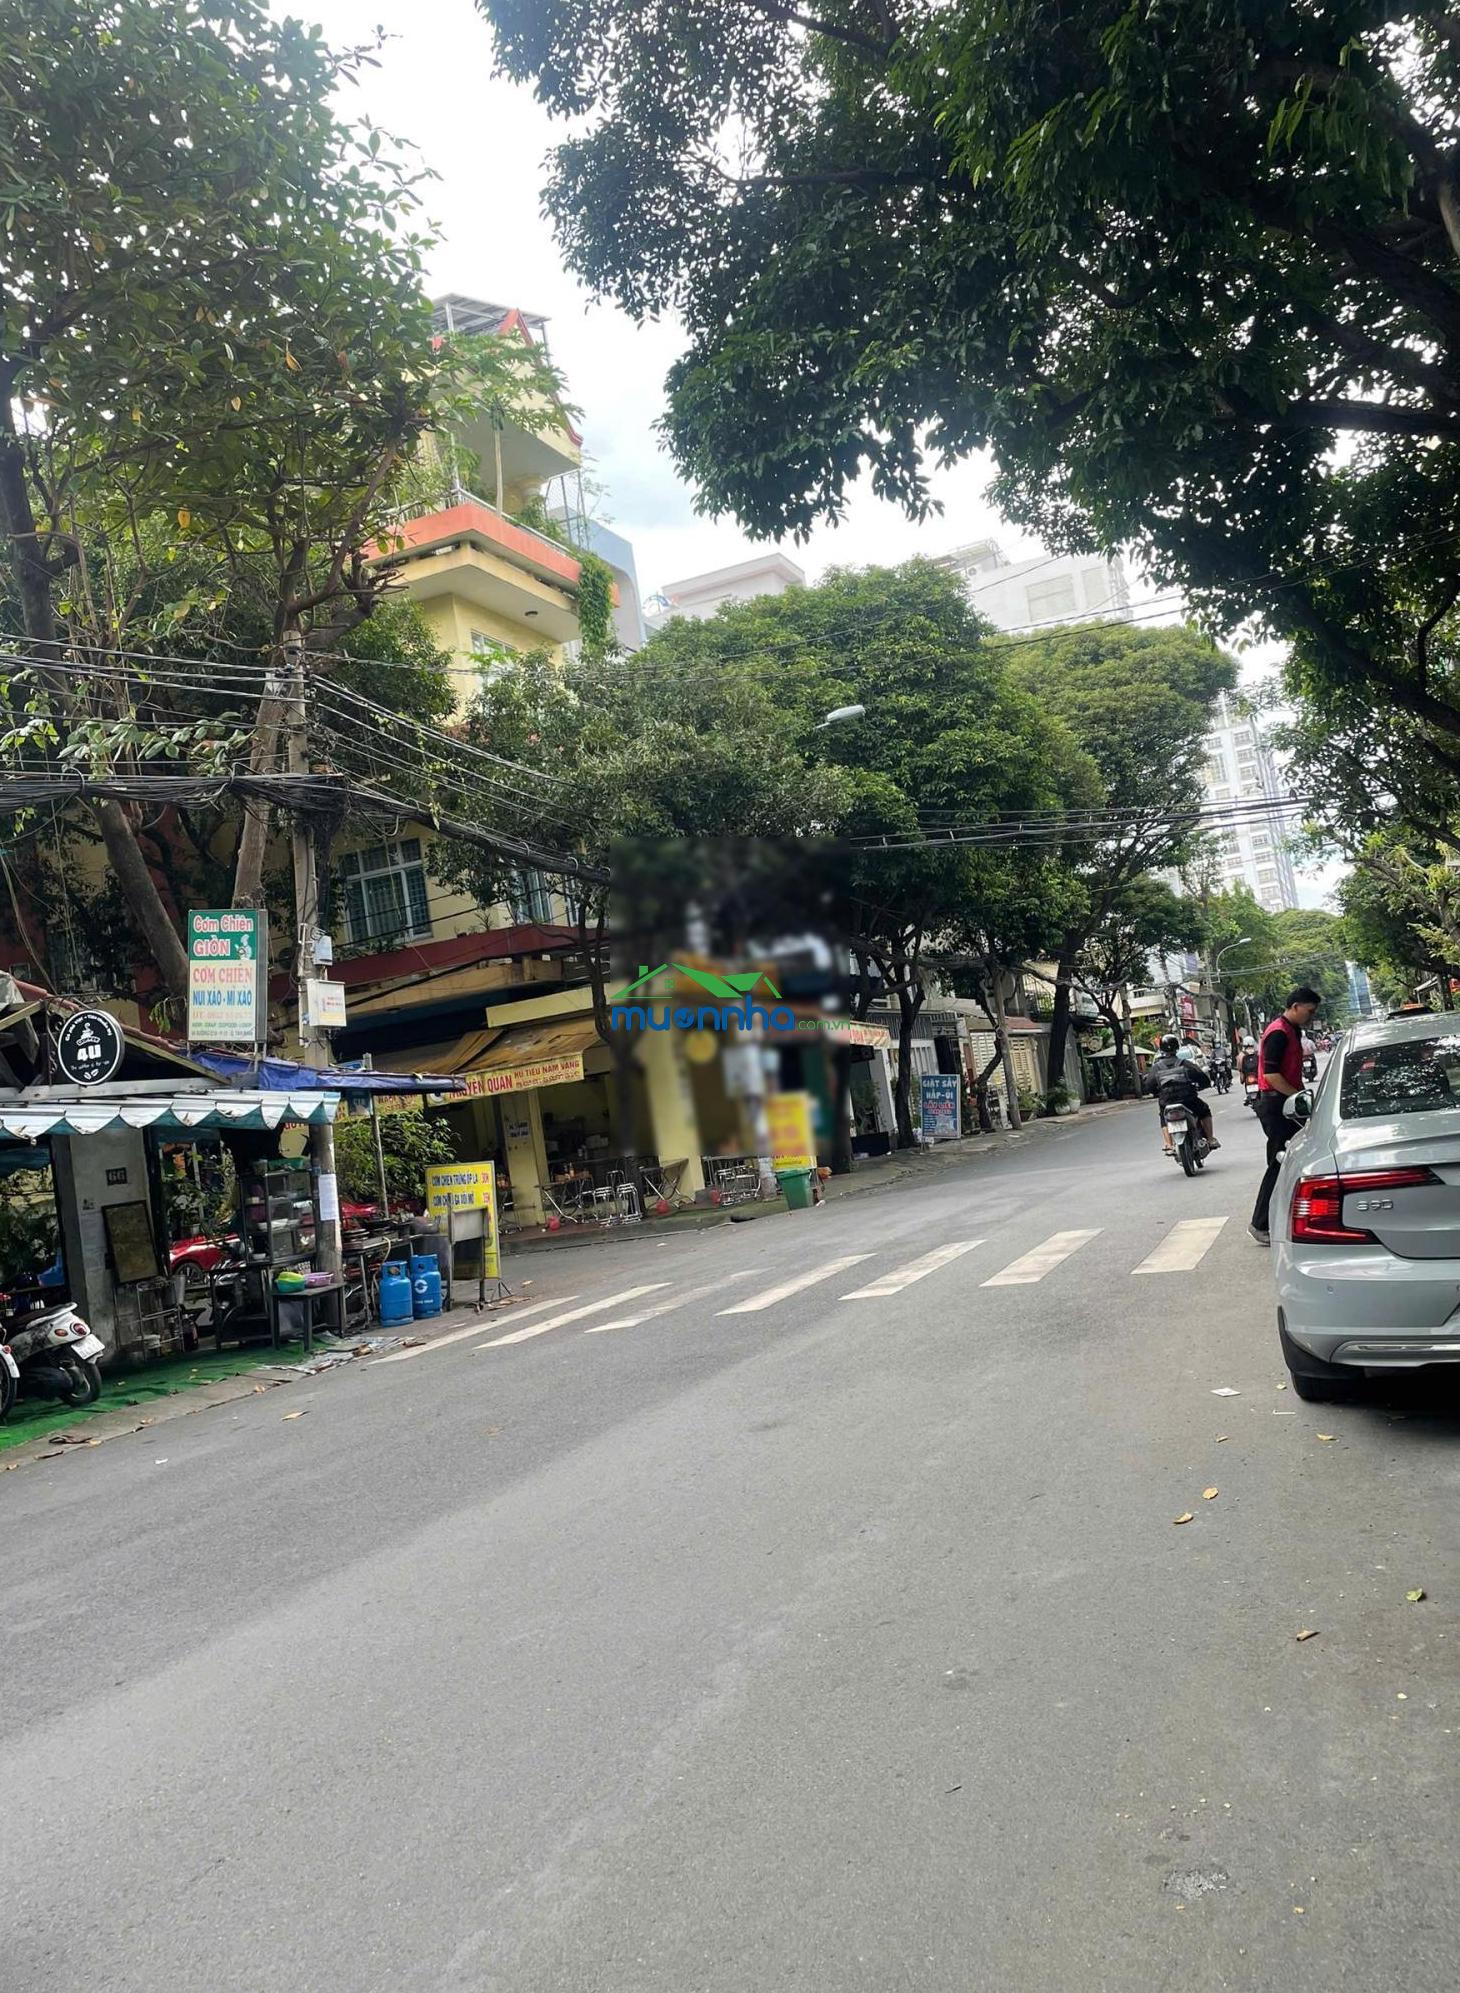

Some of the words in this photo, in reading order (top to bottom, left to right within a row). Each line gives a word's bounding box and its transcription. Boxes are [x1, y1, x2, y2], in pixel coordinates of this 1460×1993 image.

[193, 914, 219, 932] Cơm
[193, 990, 205, 1006] NUI
[77, 1044, 101, 1061] 4U
[542, 1063, 559, 1072] NAM
